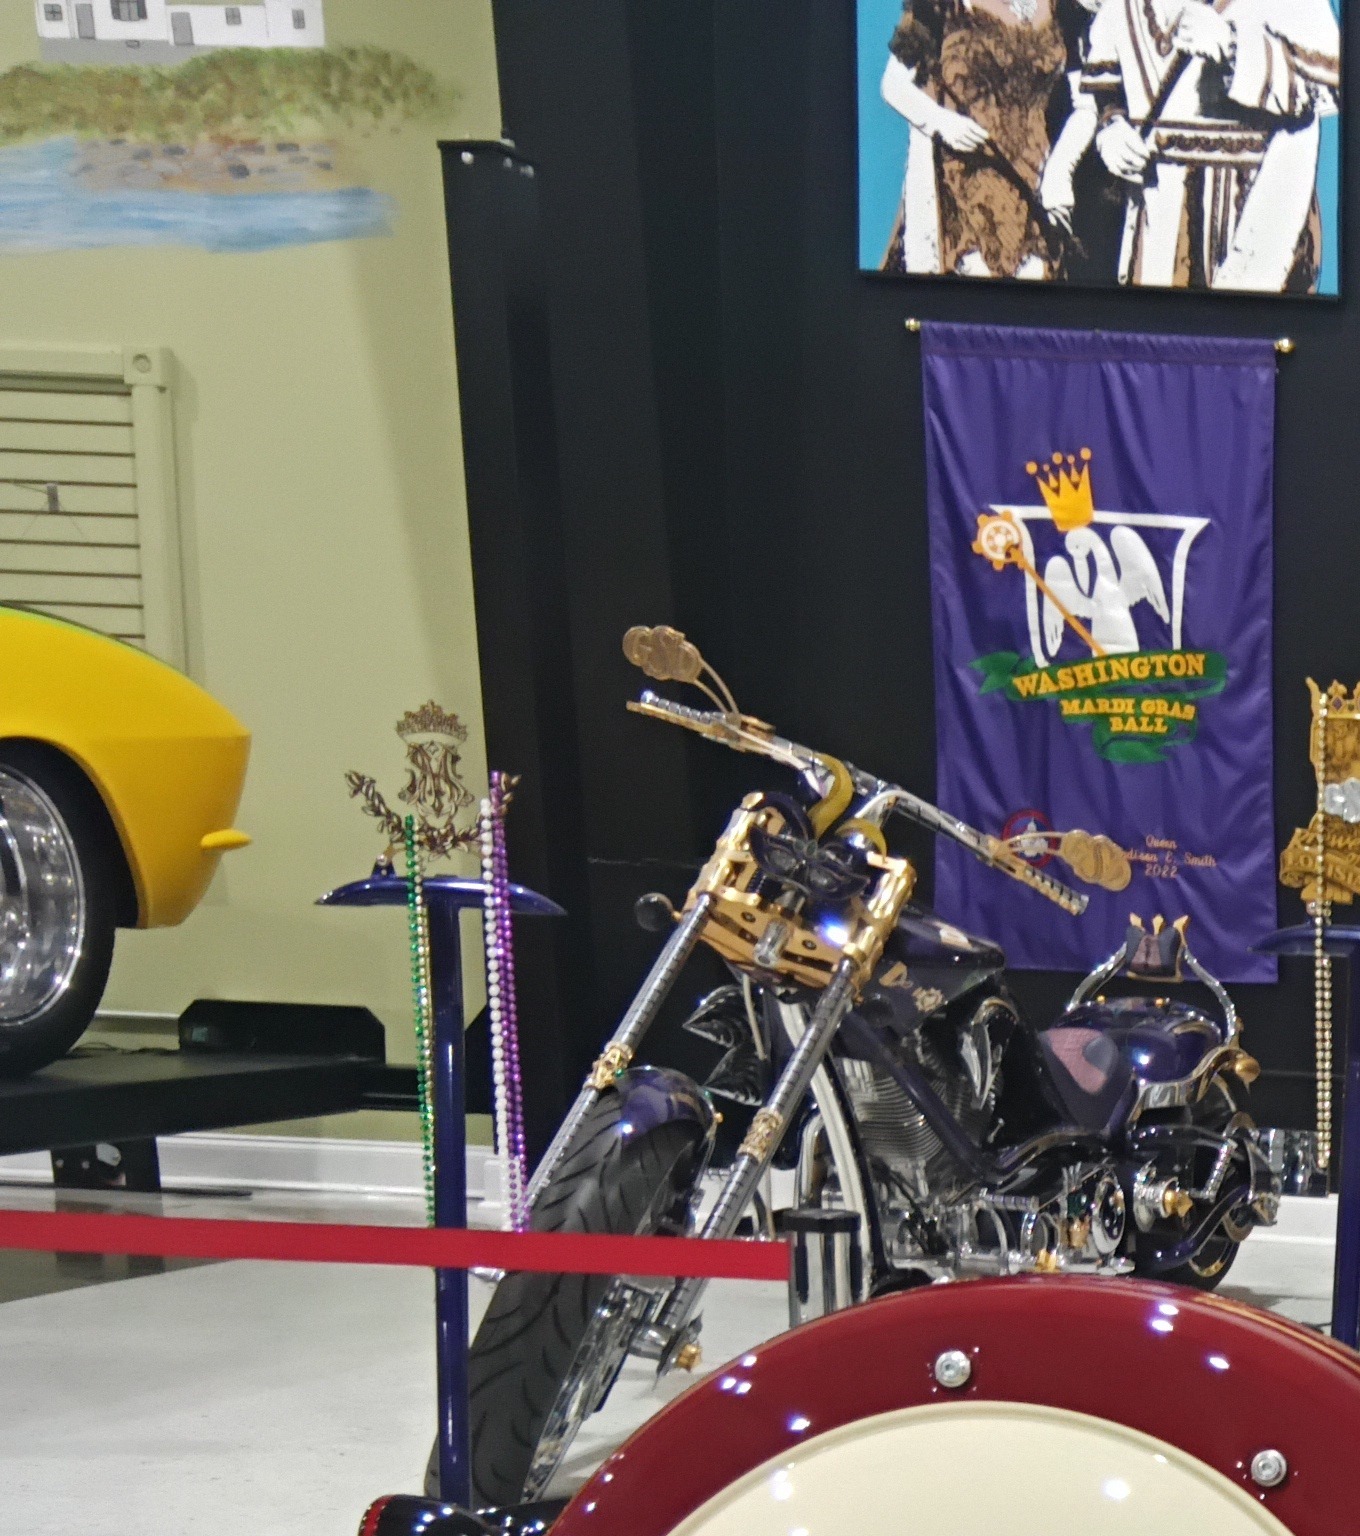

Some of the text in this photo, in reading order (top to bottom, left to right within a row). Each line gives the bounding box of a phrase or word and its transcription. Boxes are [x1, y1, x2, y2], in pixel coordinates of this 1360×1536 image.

[1012, 653, 1206, 698] WASHINGTON
[1060, 698, 1196, 721] MARDI GRAS
[1109, 716, 1168, 734] BALL
[1145, 863, 1178, 879] 2022
